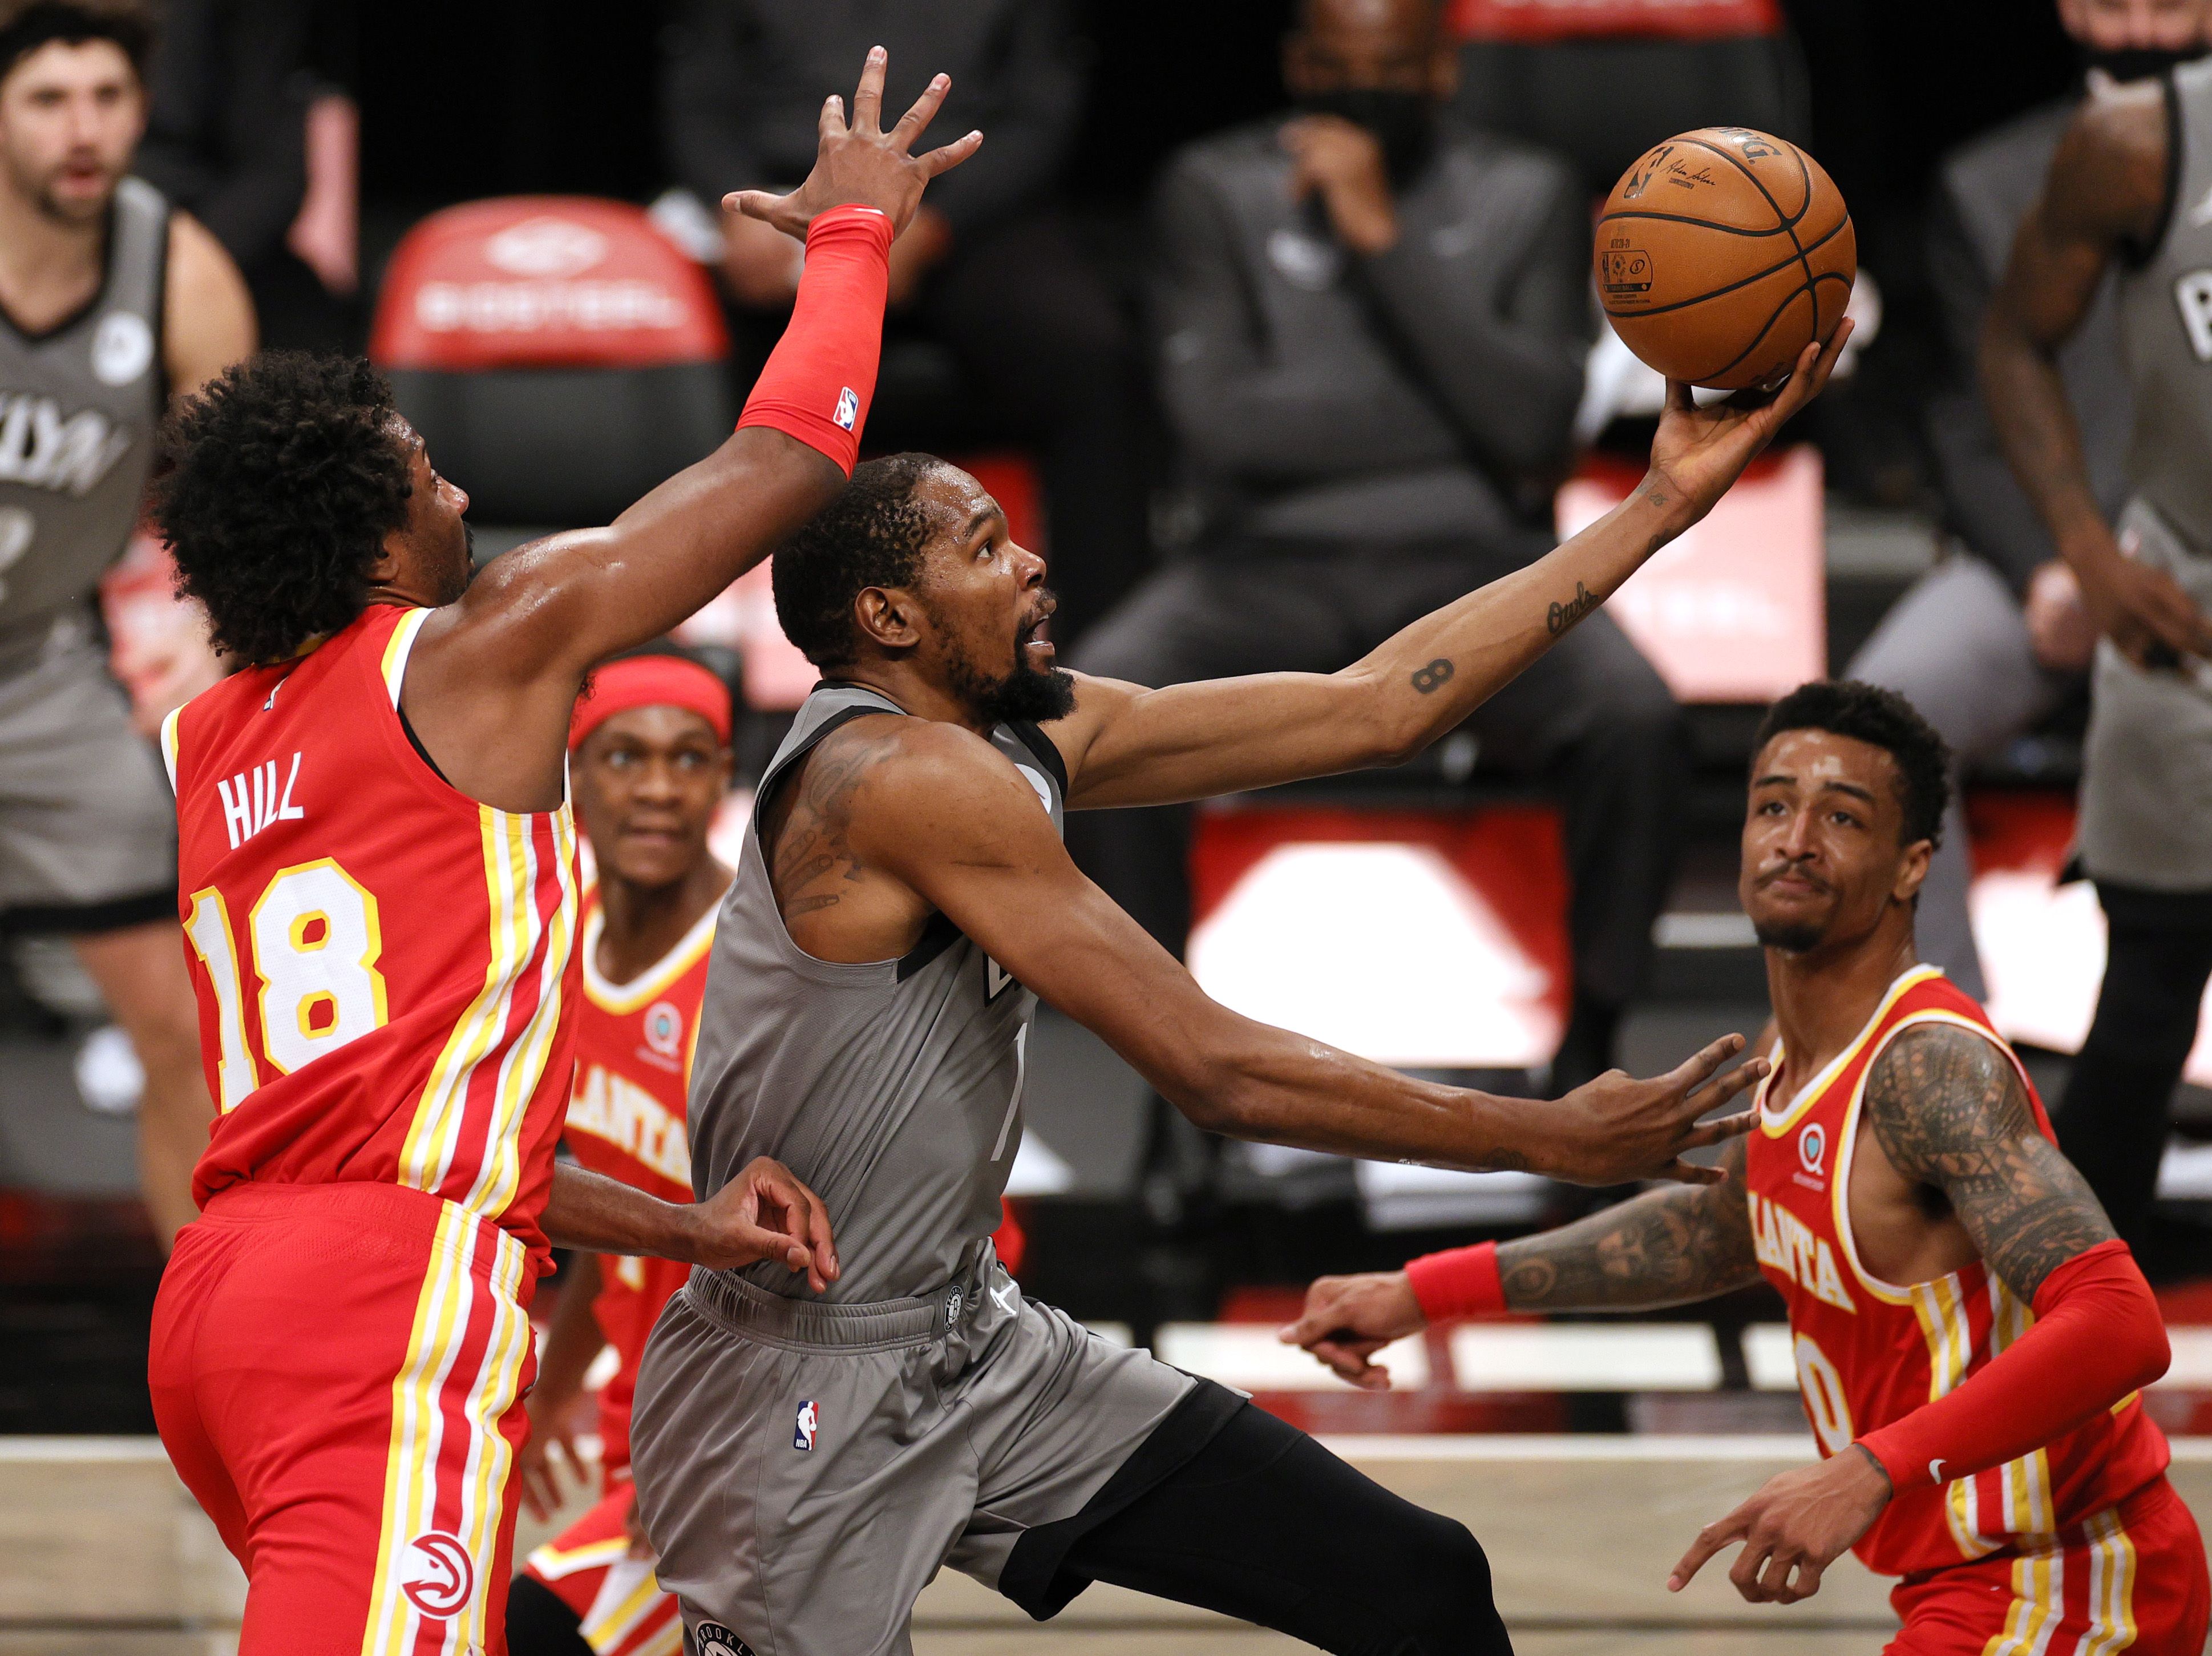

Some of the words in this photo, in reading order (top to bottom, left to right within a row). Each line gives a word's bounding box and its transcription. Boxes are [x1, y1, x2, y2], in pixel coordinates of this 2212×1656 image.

[1547, 581, 1599, 633] Owls
[1411, 658, 1454, 694] 8
[216, 750, 304, 851] HILL
[182, 856, 389, 1116] 18
[795, 1438, 808, 1449] NBA
[698, 1626, 753, 1656] BROOKL
